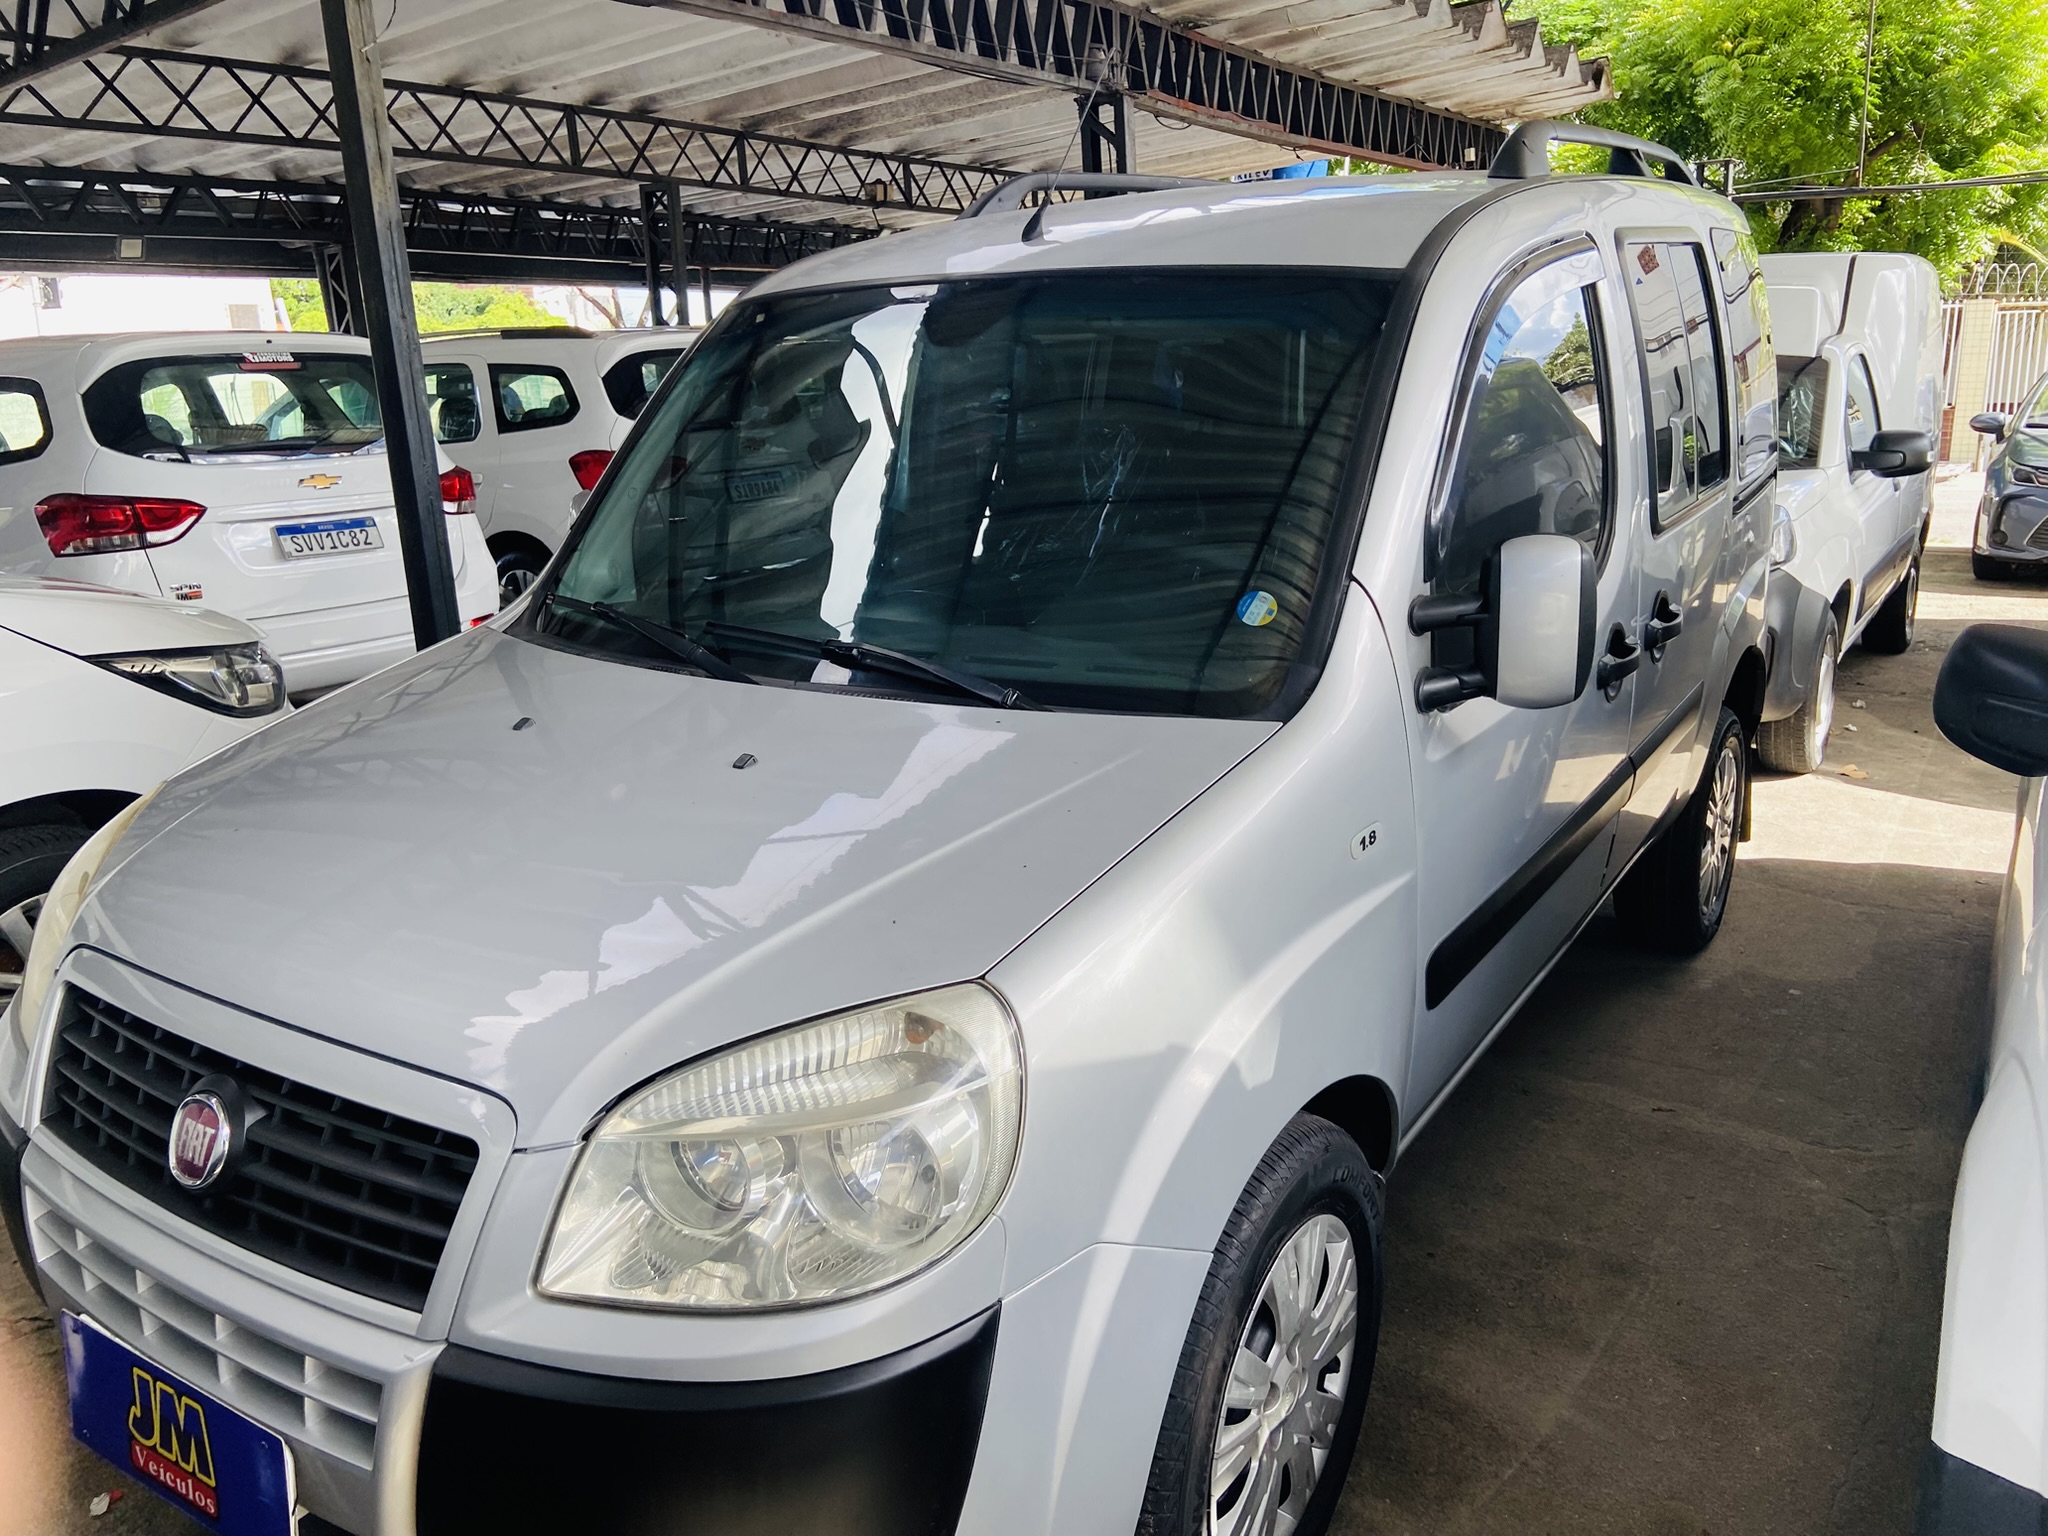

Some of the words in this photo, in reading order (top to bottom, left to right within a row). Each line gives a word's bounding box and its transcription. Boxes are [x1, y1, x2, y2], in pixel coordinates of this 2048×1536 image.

[290, 529, 373, 553] SVV1C82
[1359, 829, 1377, 852] 1.8
[178, 1117, 216, 1167] FIAT
[128, 1366, 216, 1488] JM
